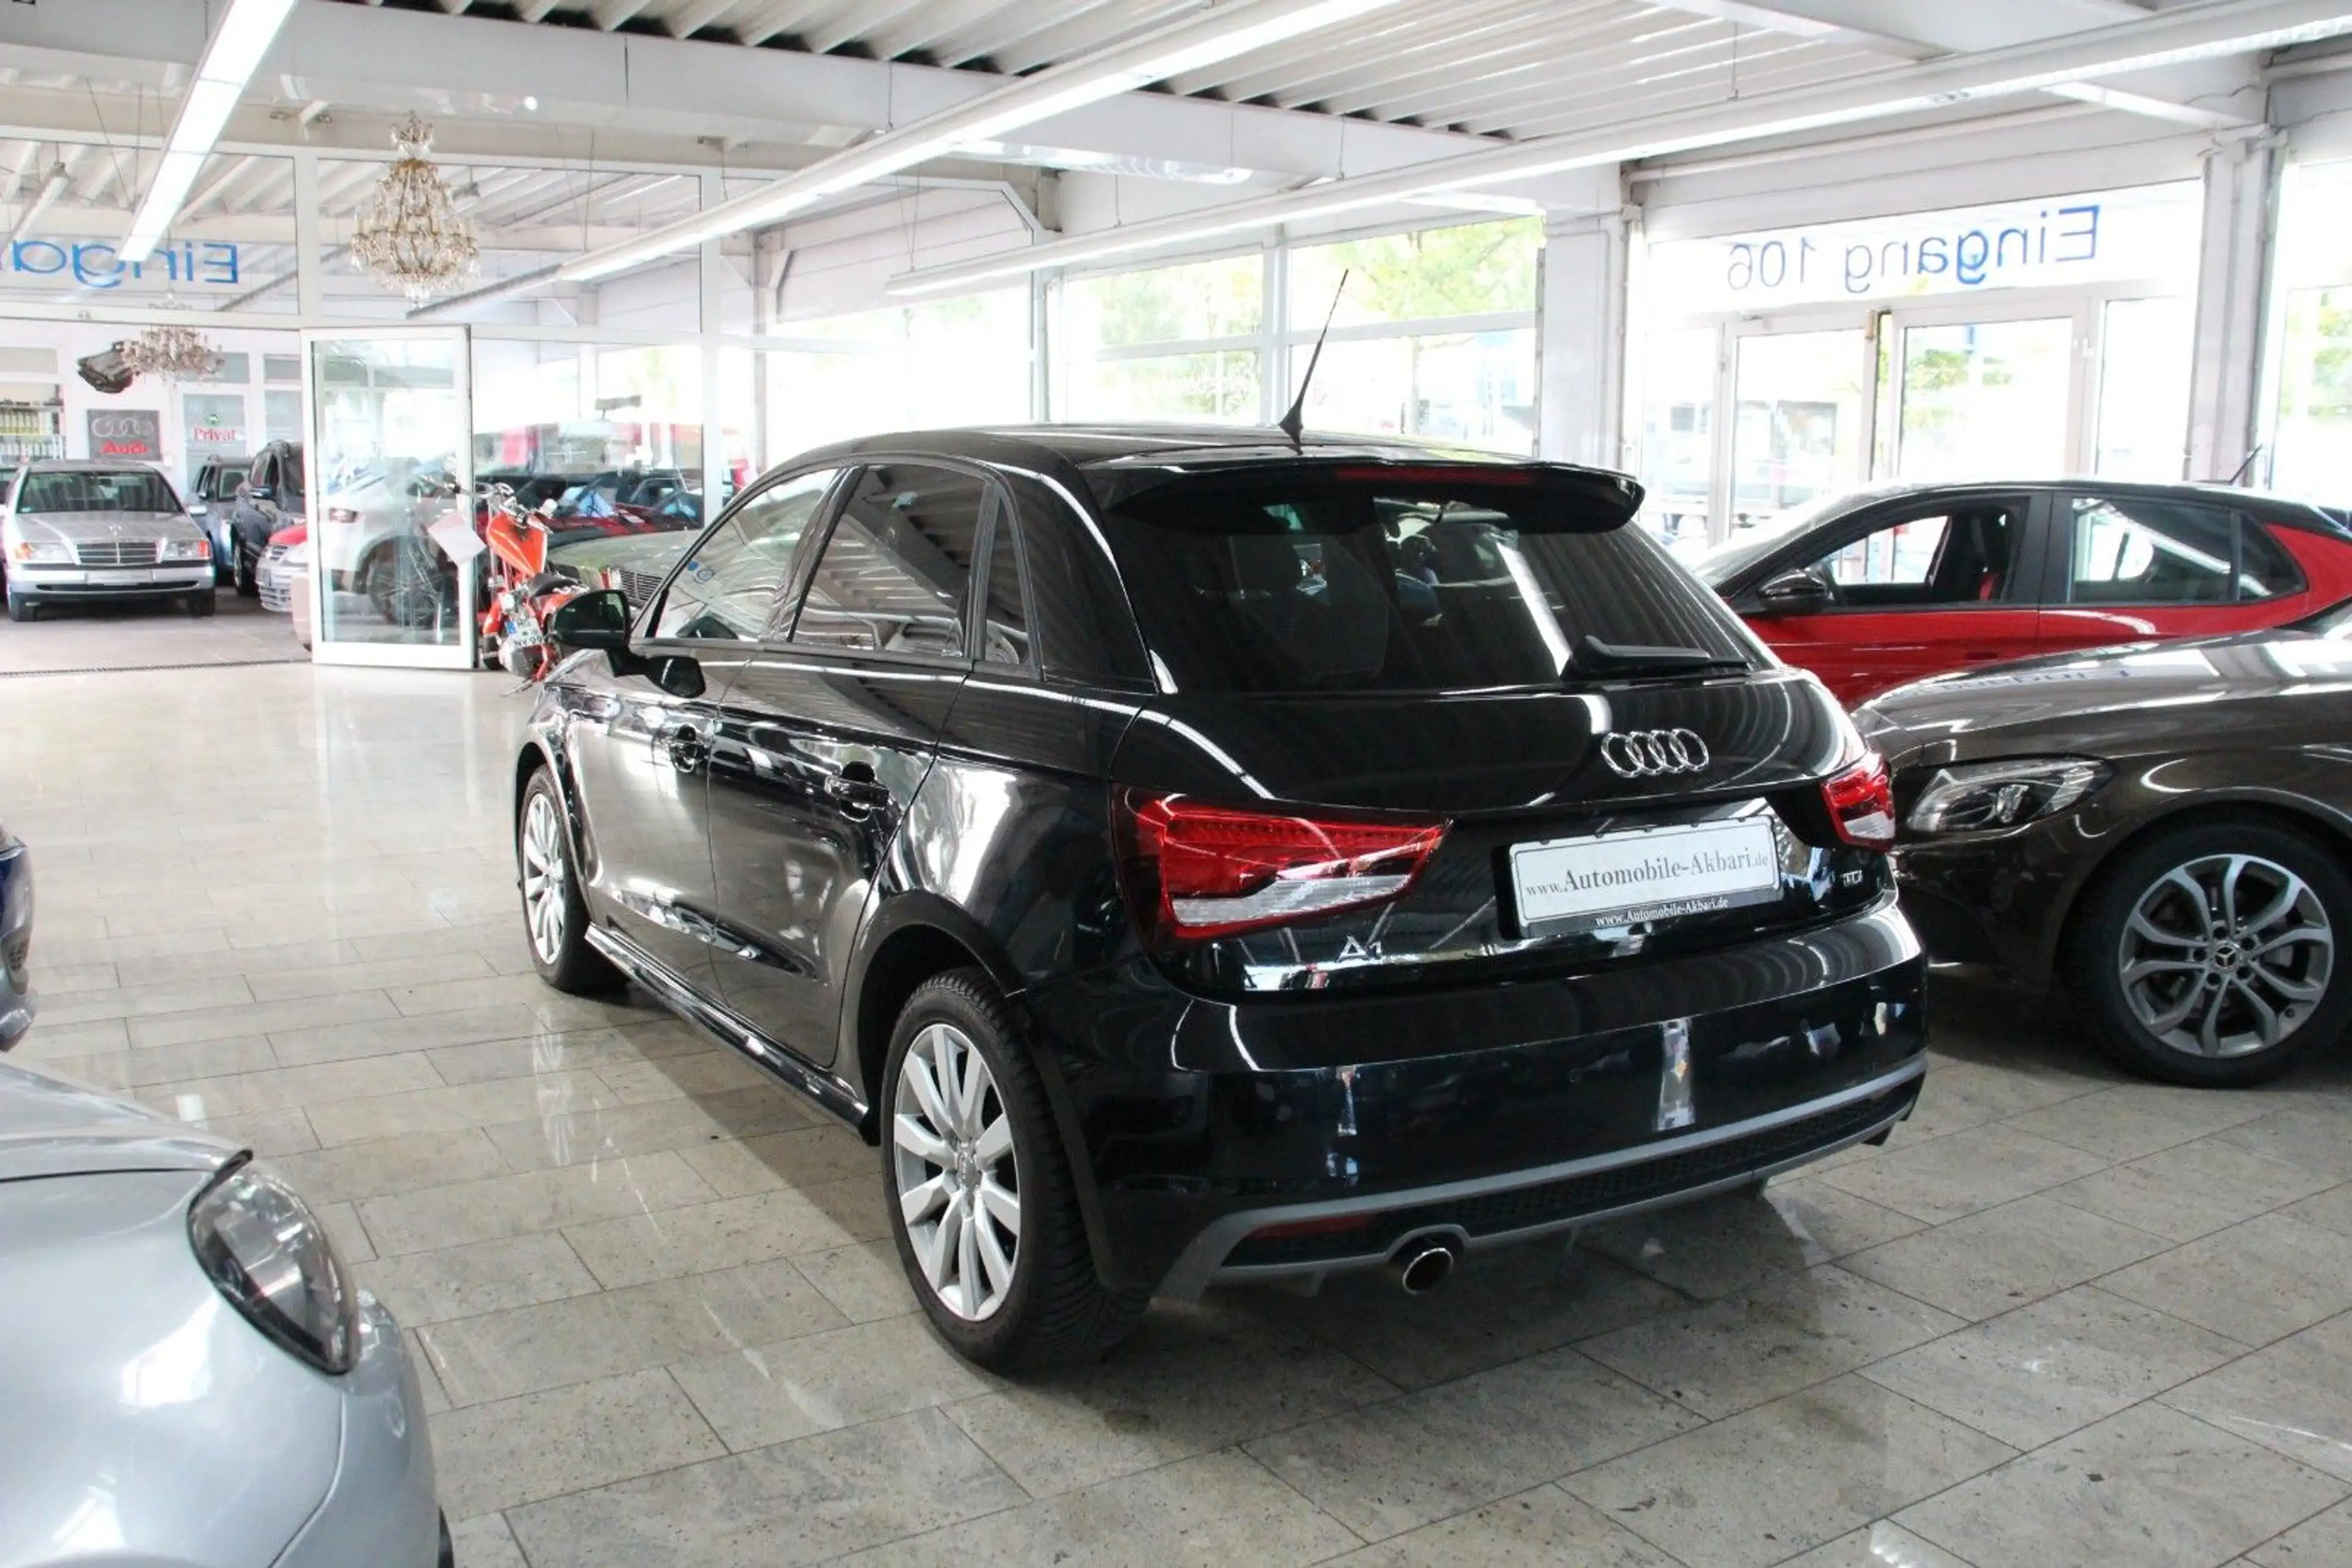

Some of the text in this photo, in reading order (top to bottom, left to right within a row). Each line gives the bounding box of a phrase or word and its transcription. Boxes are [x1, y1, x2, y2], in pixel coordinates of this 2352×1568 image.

[1525, 846, 1770, 897] www.Automobile-Akbari.de
[1595, 896, 1728, 927] www.Automobile-Akbari.de
[1336, 935, 1382, 963] A1
